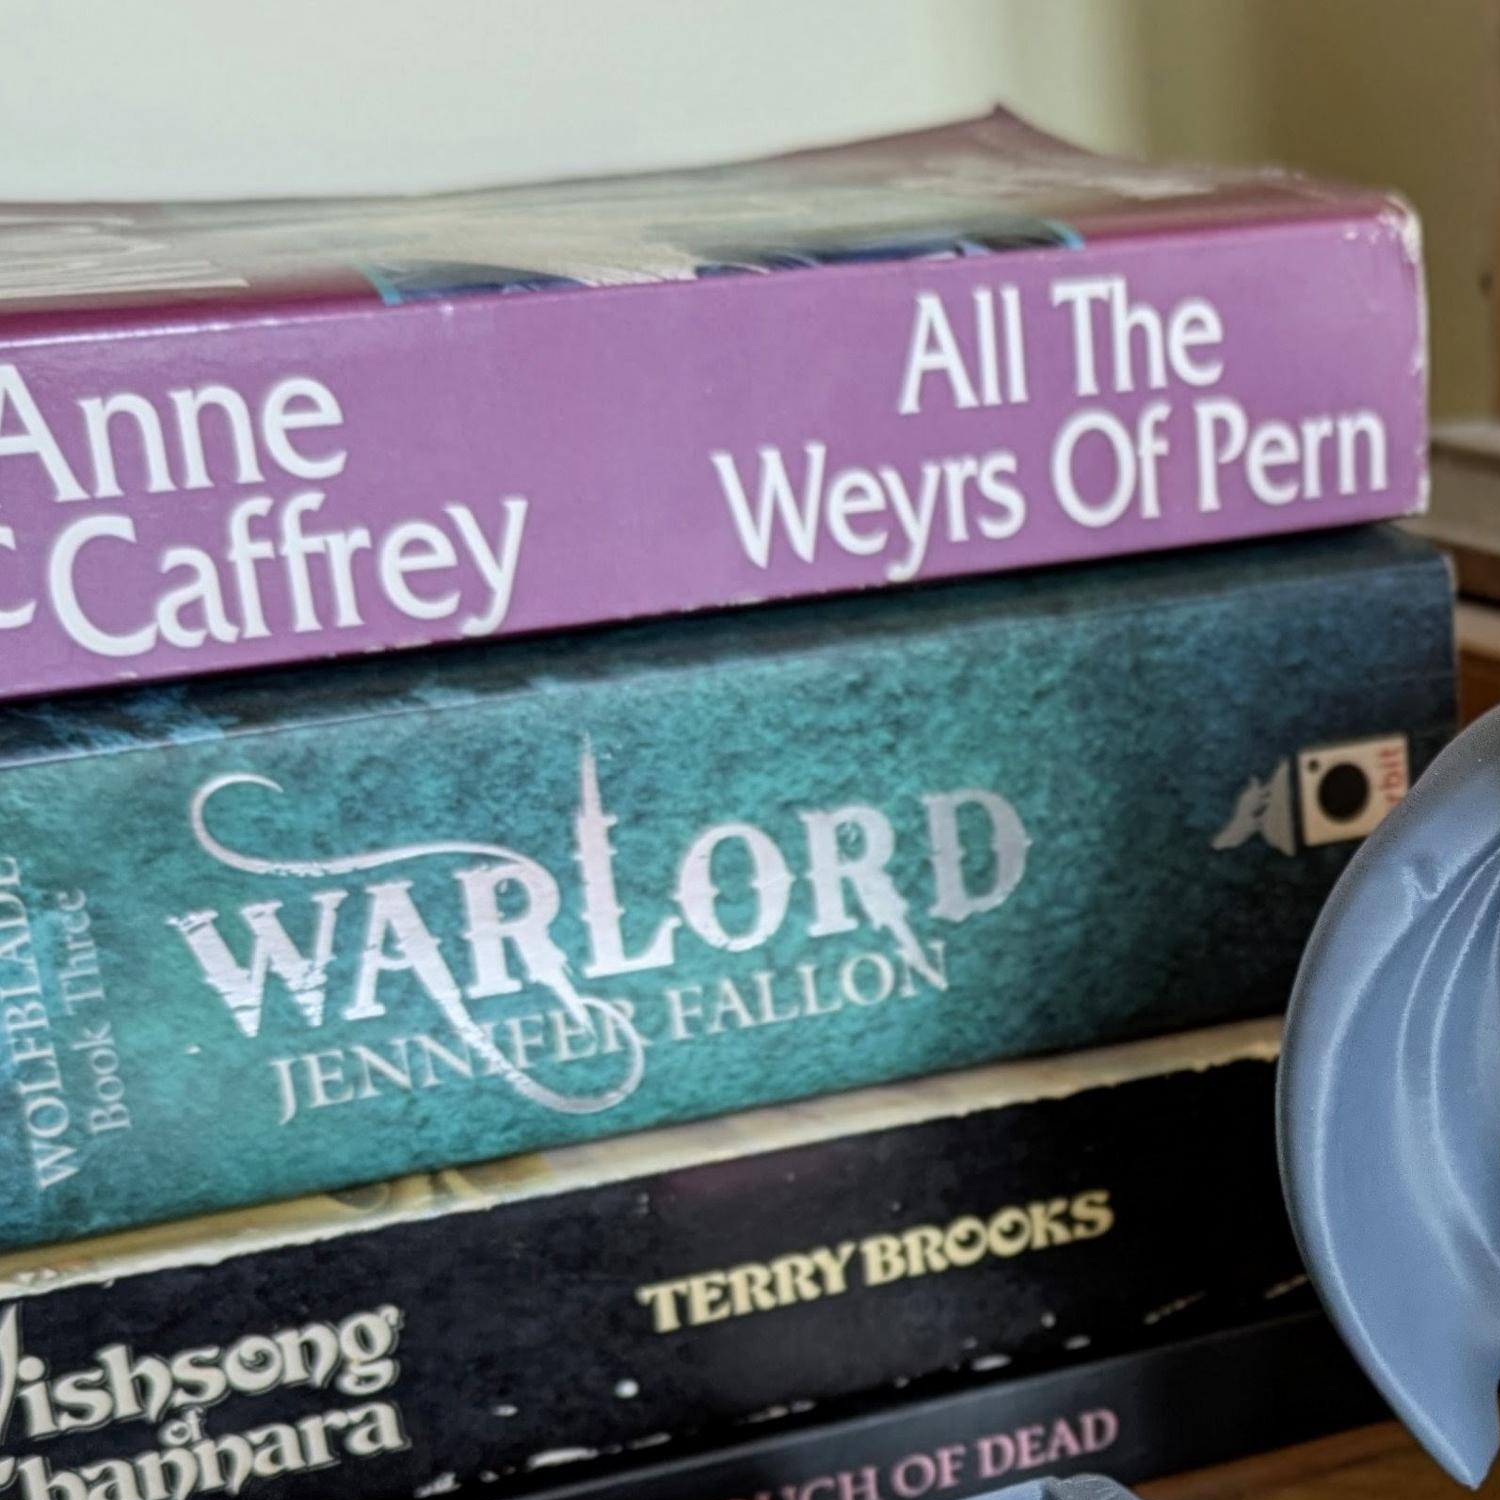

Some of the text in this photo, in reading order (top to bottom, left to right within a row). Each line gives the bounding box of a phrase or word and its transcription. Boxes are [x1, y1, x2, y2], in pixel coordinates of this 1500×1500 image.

[898, 273, 1223, 414] All The
[0, 363, 347, 502] Anne
[711, 398, 1388, 582] Weyrs Of Pern
[165, 732, 1032, 1112] WARLORD
[56, 887, 133, 1134] Book Three
[272, 939, 948, 1125] JENNIFER FALLON
[637, 1189, 1114, 1333] TERRY BROOKS
[160, 1405, 204, 1447] of
[892, 1452, 964, 1500] OF
[976, 1408, 1119, 1481] DEAD
